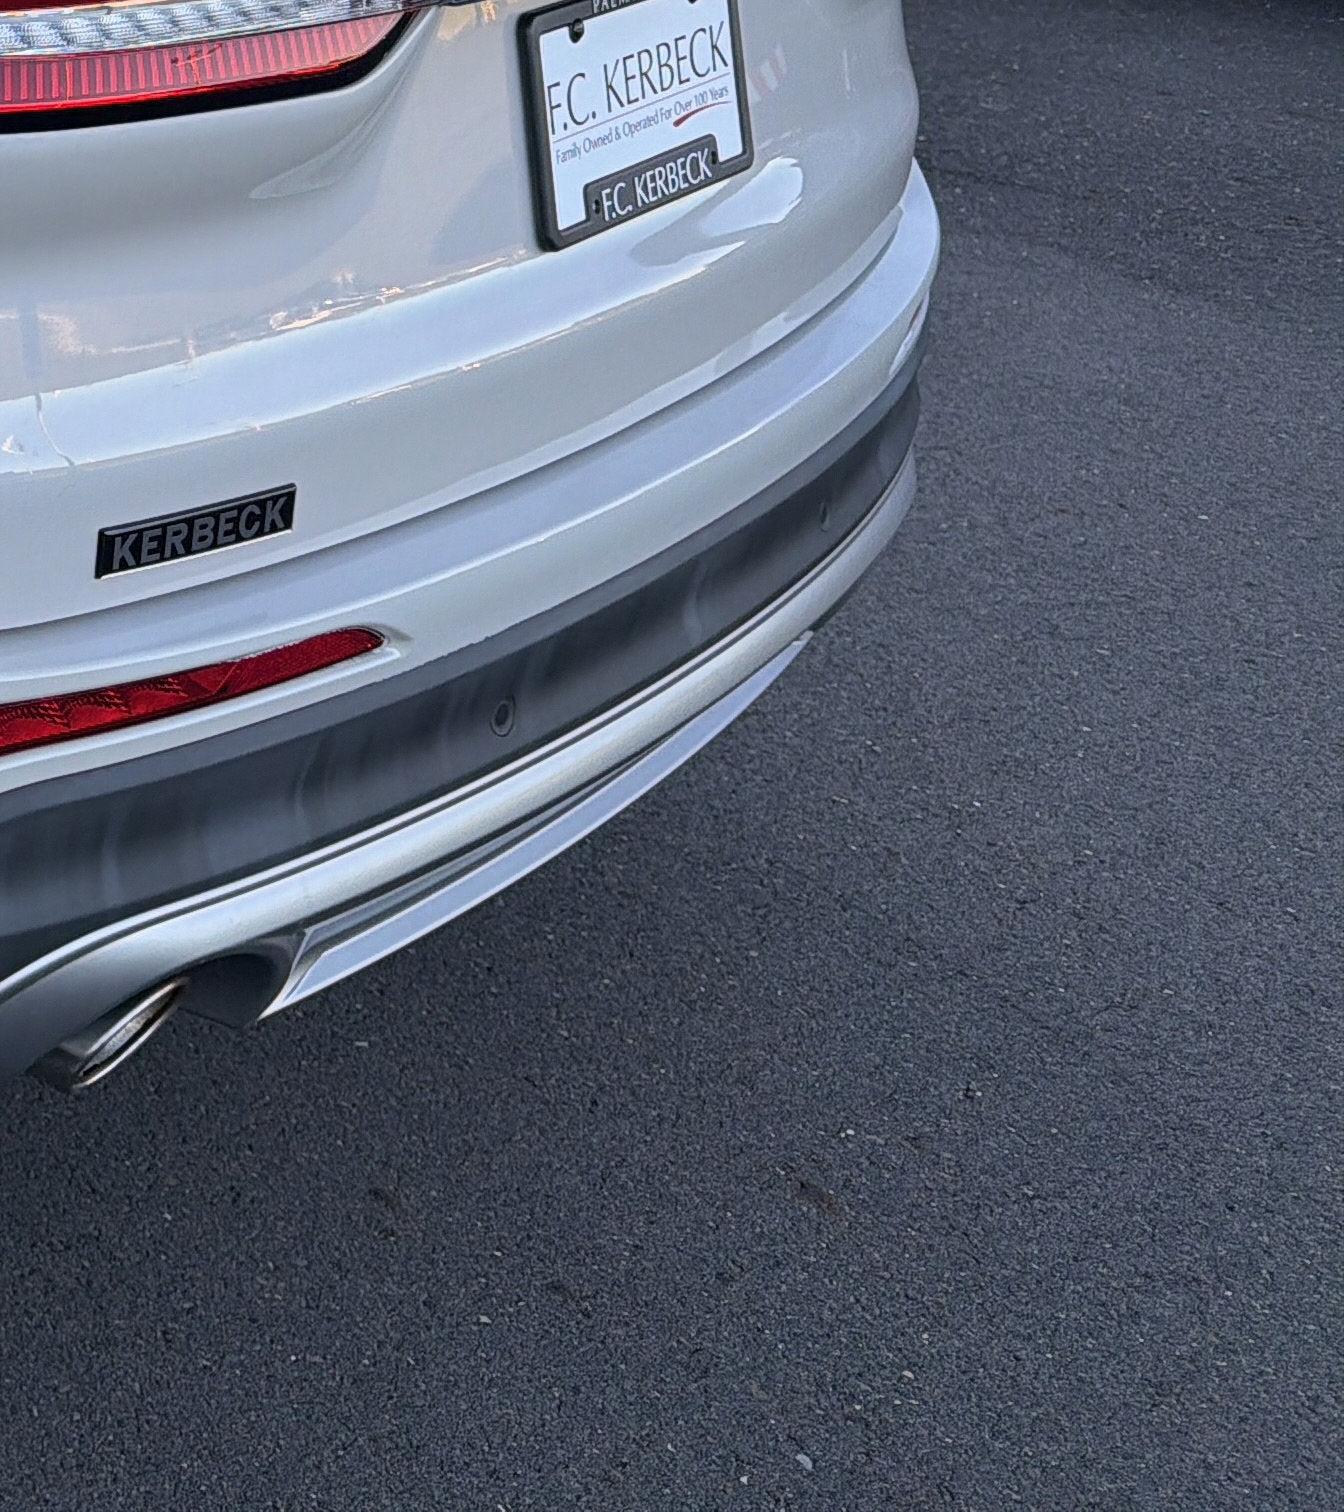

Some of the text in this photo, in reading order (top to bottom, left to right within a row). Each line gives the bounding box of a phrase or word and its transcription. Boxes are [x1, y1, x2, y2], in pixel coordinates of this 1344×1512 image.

[547, 20, 729, 136] F.C. KERBECK
[555, 140, 582, 165] Family
[583, 132, 613, 154] Owned
[622, 109, 660, 137] Operated
[661, 107, 673, 124] For
[673, 99, 693, 116] Over
[694, 90, 709, 106] 100
[709, 85, 730, 101] Years
[600, 147, 713, 222] F.C. KERBECK
[112, 495, 288, 570] KERBECK
